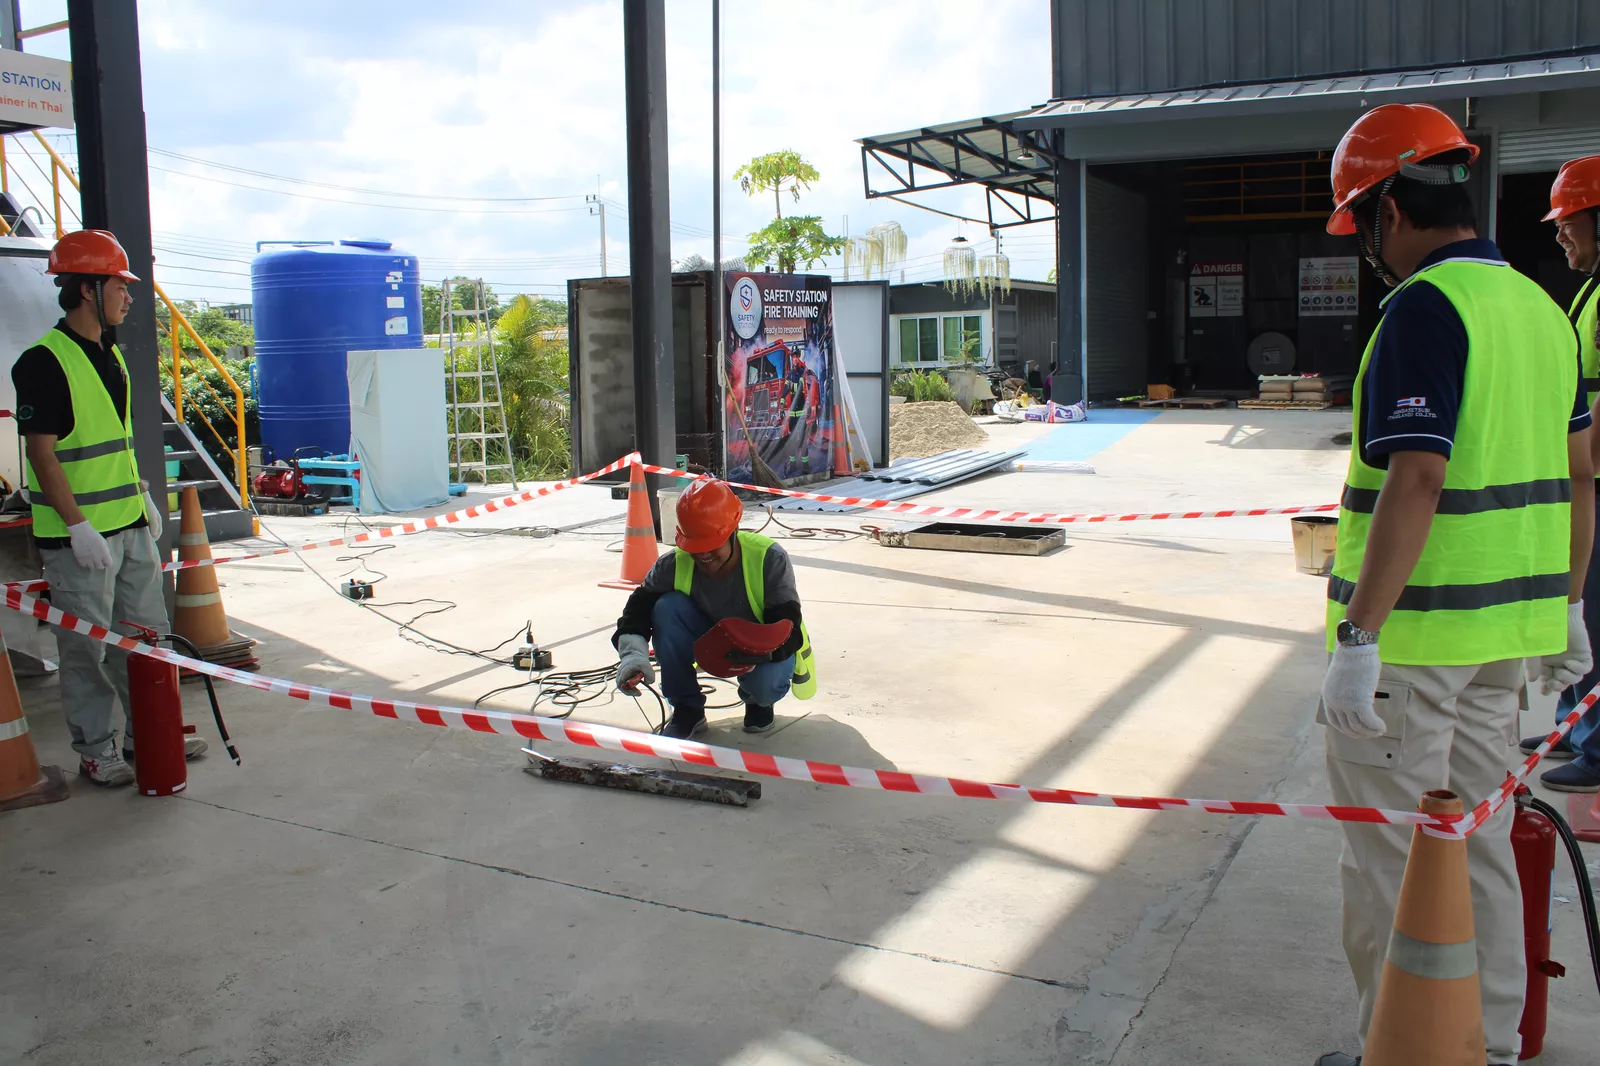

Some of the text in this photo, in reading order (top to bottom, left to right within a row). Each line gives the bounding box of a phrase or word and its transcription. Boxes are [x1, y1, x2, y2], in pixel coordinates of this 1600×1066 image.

[1, 71, 61, 92] STATION
[28, 99, 38, 109] in
[40, 100, 63, 112] Thai
[1203, 263, 1243, 273] DANGER
[763, 288, 828, 302] SAFETY STATION
[737, 314, 755, 322] SAFETY
[764, 305, 819, 318] FIRE TRAINING
[763, 326, 802, 335] ready to respond
